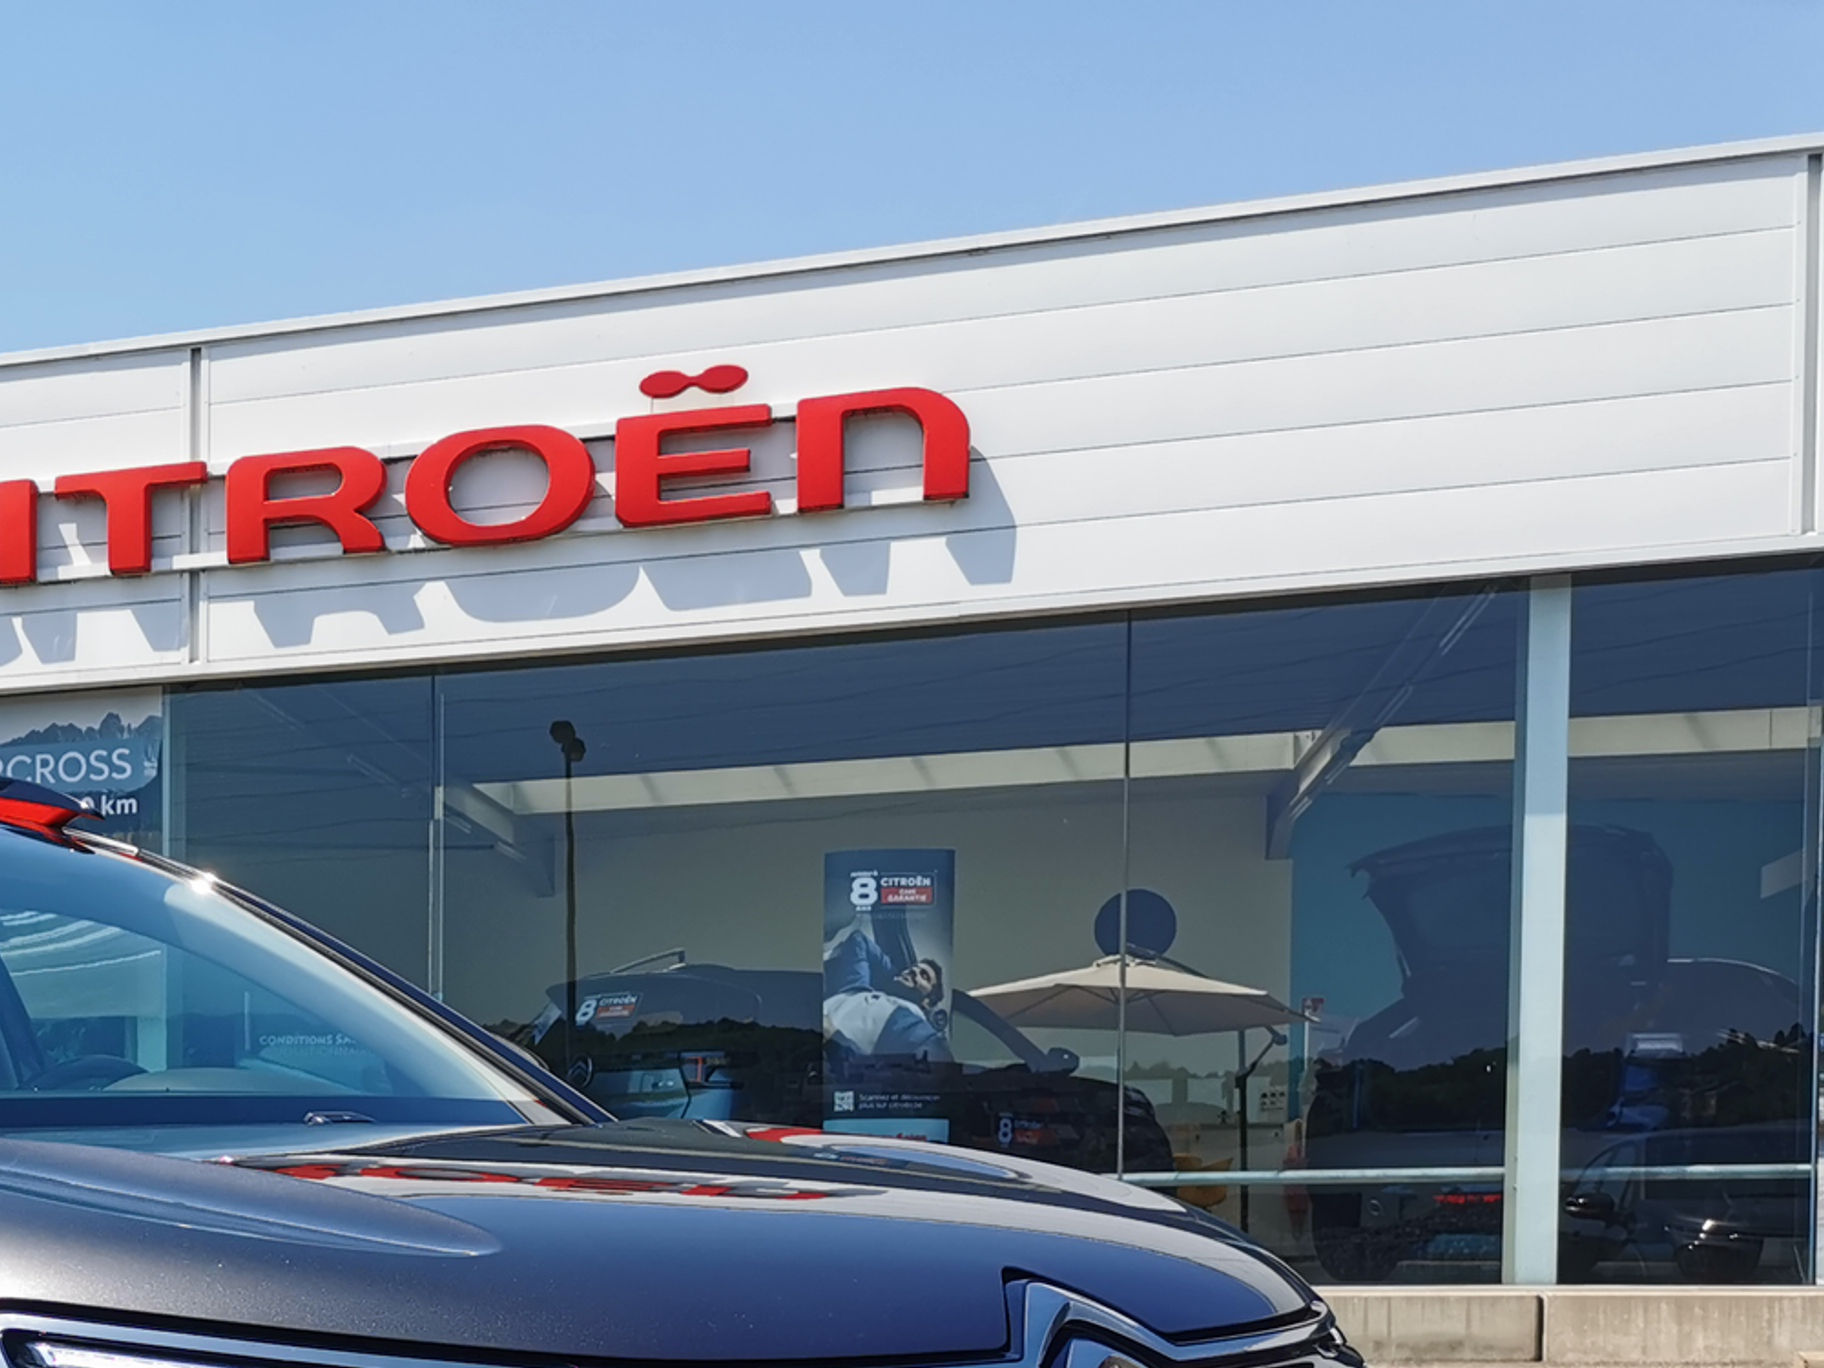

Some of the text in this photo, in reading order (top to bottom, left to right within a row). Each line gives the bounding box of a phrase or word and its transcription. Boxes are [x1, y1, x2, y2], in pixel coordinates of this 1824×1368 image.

[100, 795, 138, 816] km
[880, 875, 931, 886] CITROËN
[850, 877, 879, 906] 8
[259, 1033, 334, 1046] CONDITIONS
